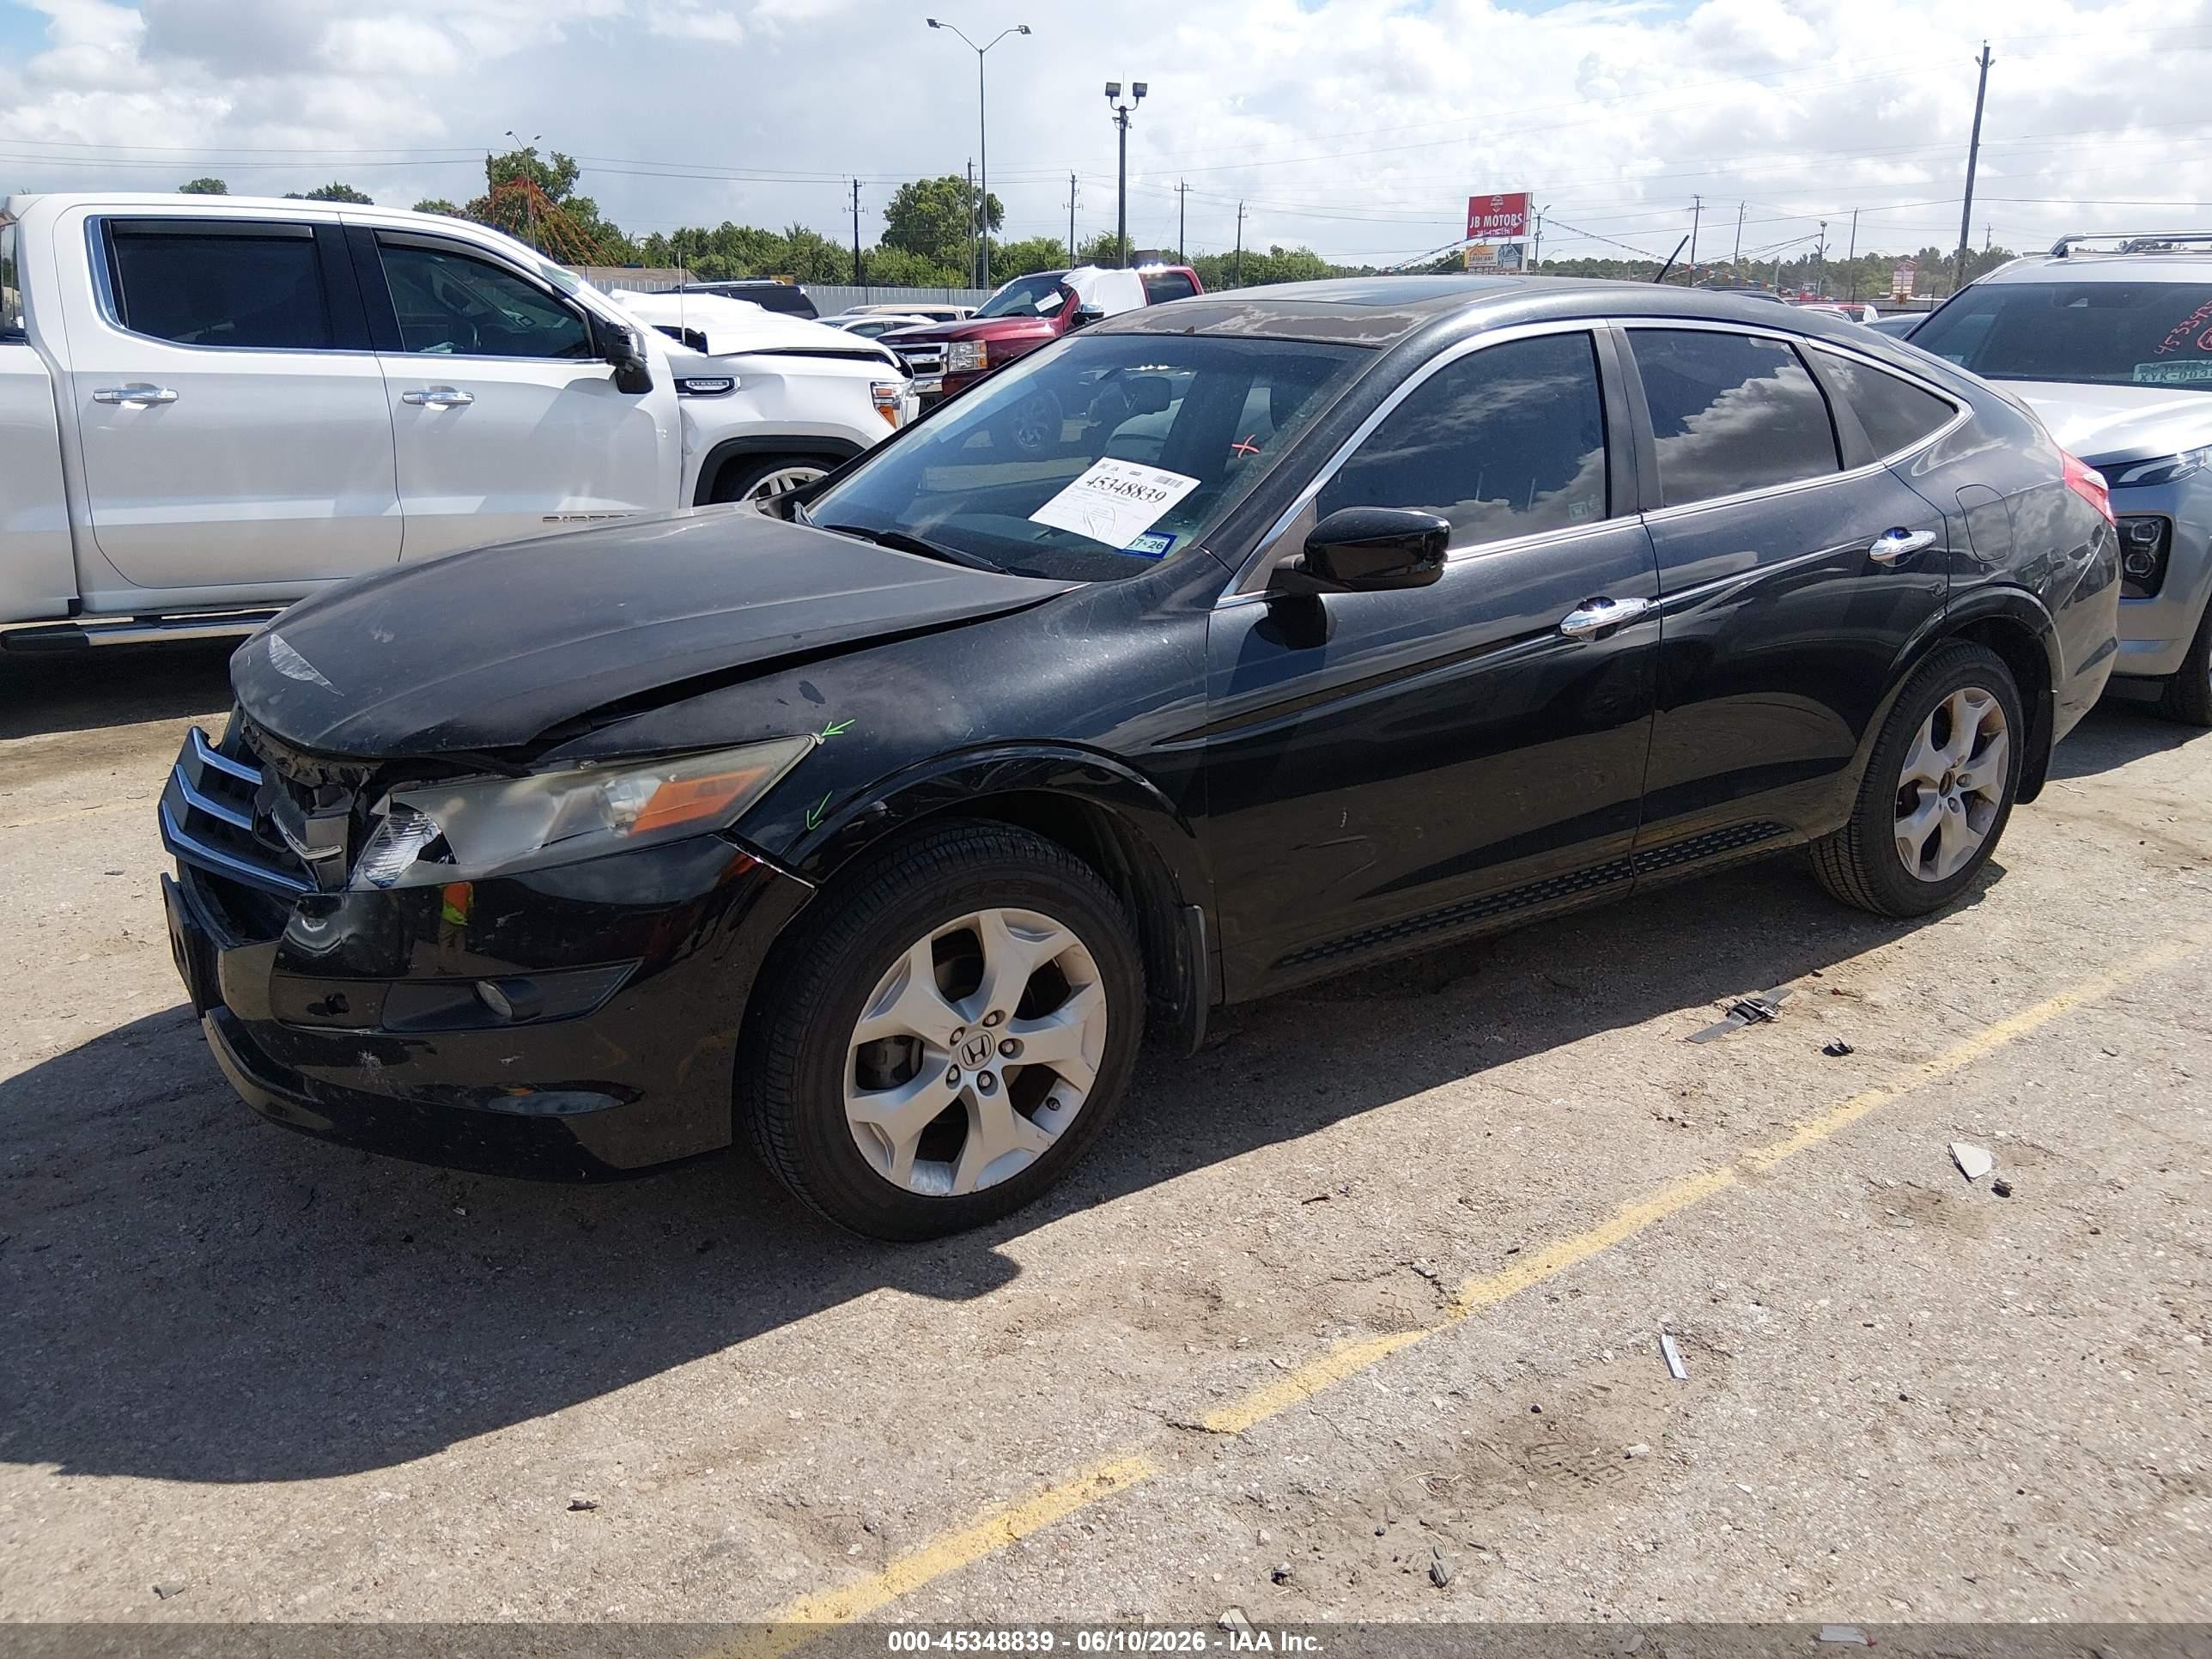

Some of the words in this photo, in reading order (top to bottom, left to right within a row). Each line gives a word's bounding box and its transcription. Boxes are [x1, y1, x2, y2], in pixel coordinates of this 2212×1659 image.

[1470, 216, 1480, 228] JB
[1484, 213, 1522, 228] MOTORS
[1086, 475, 1167, 503] 45348839
